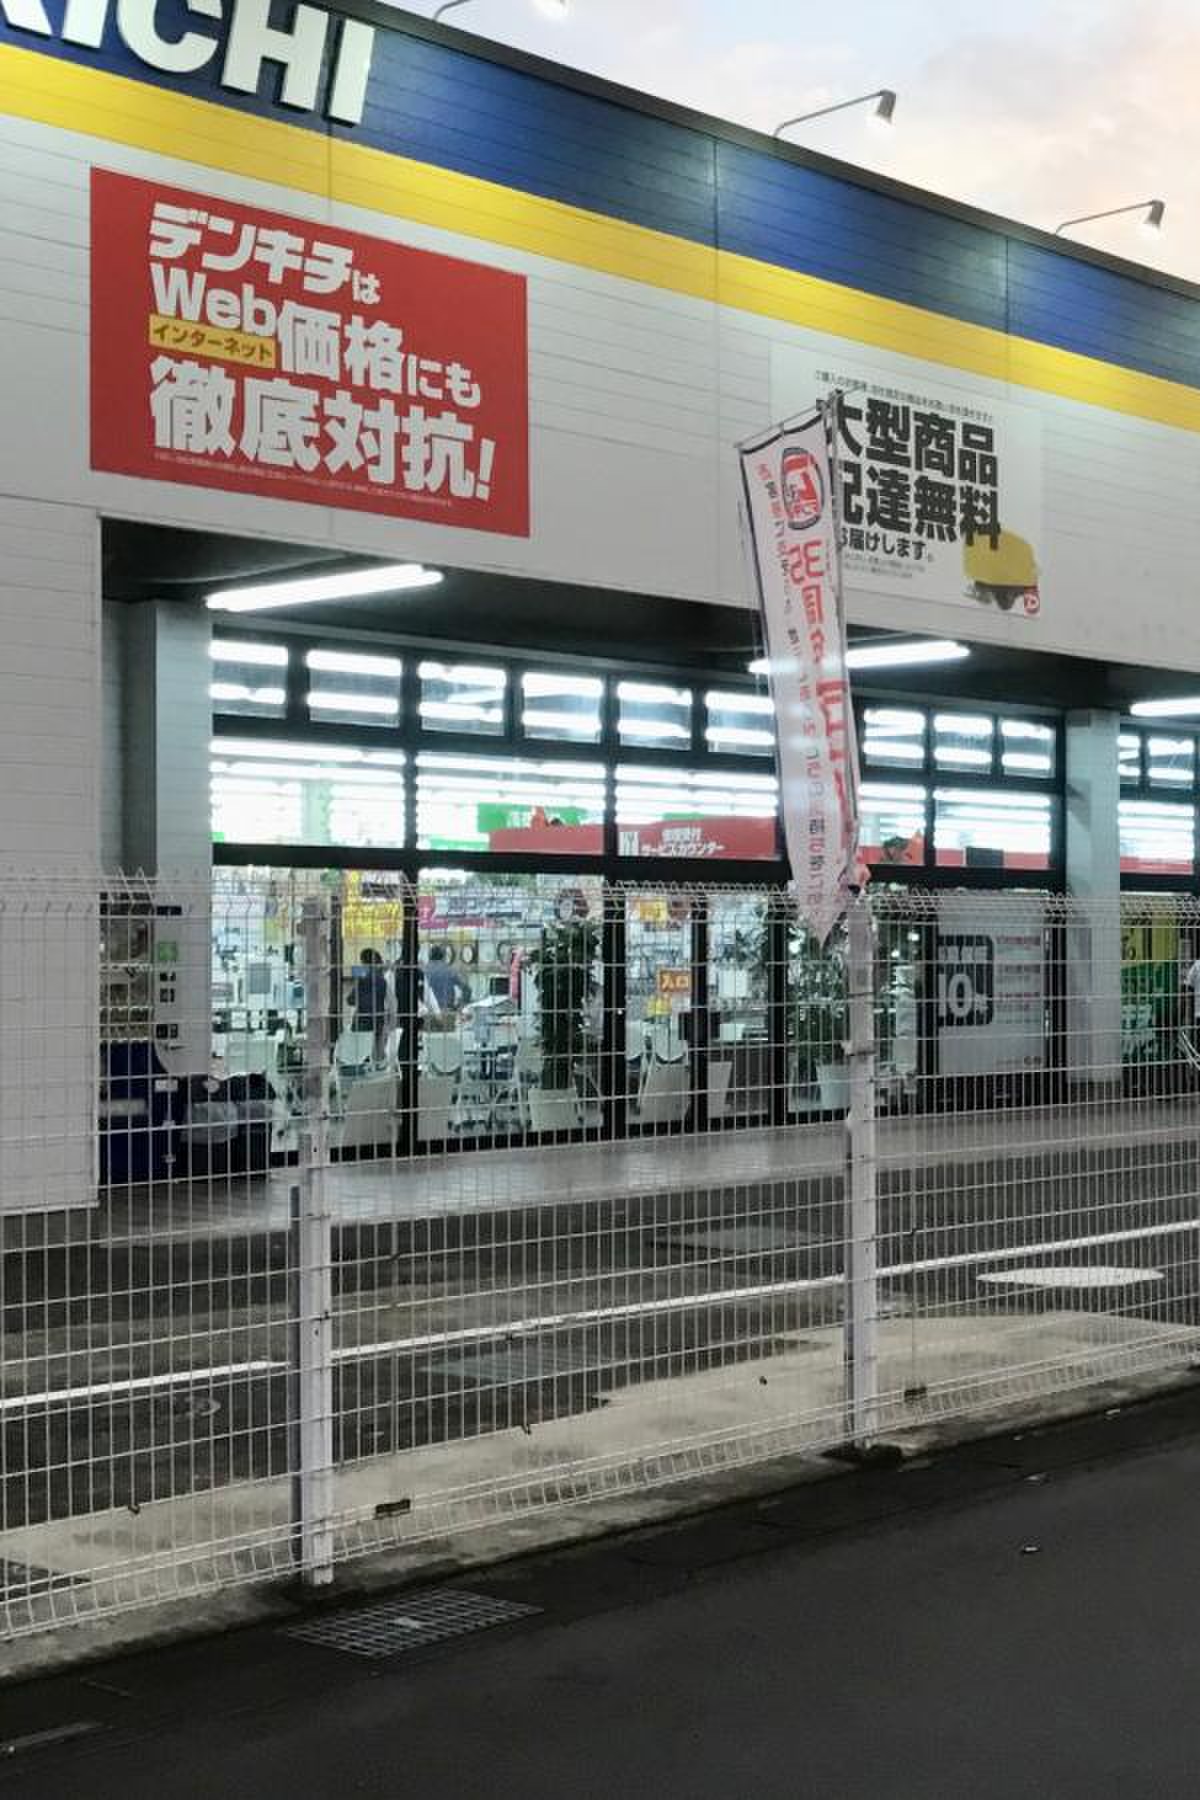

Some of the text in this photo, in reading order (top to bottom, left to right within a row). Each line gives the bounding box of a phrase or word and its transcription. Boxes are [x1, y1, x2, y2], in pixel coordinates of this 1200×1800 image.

[149, 202, 382, 305] デンキチは
[150, 262, 481, 408] Web価格にも
[153, 324, 272, 362] インターネット
